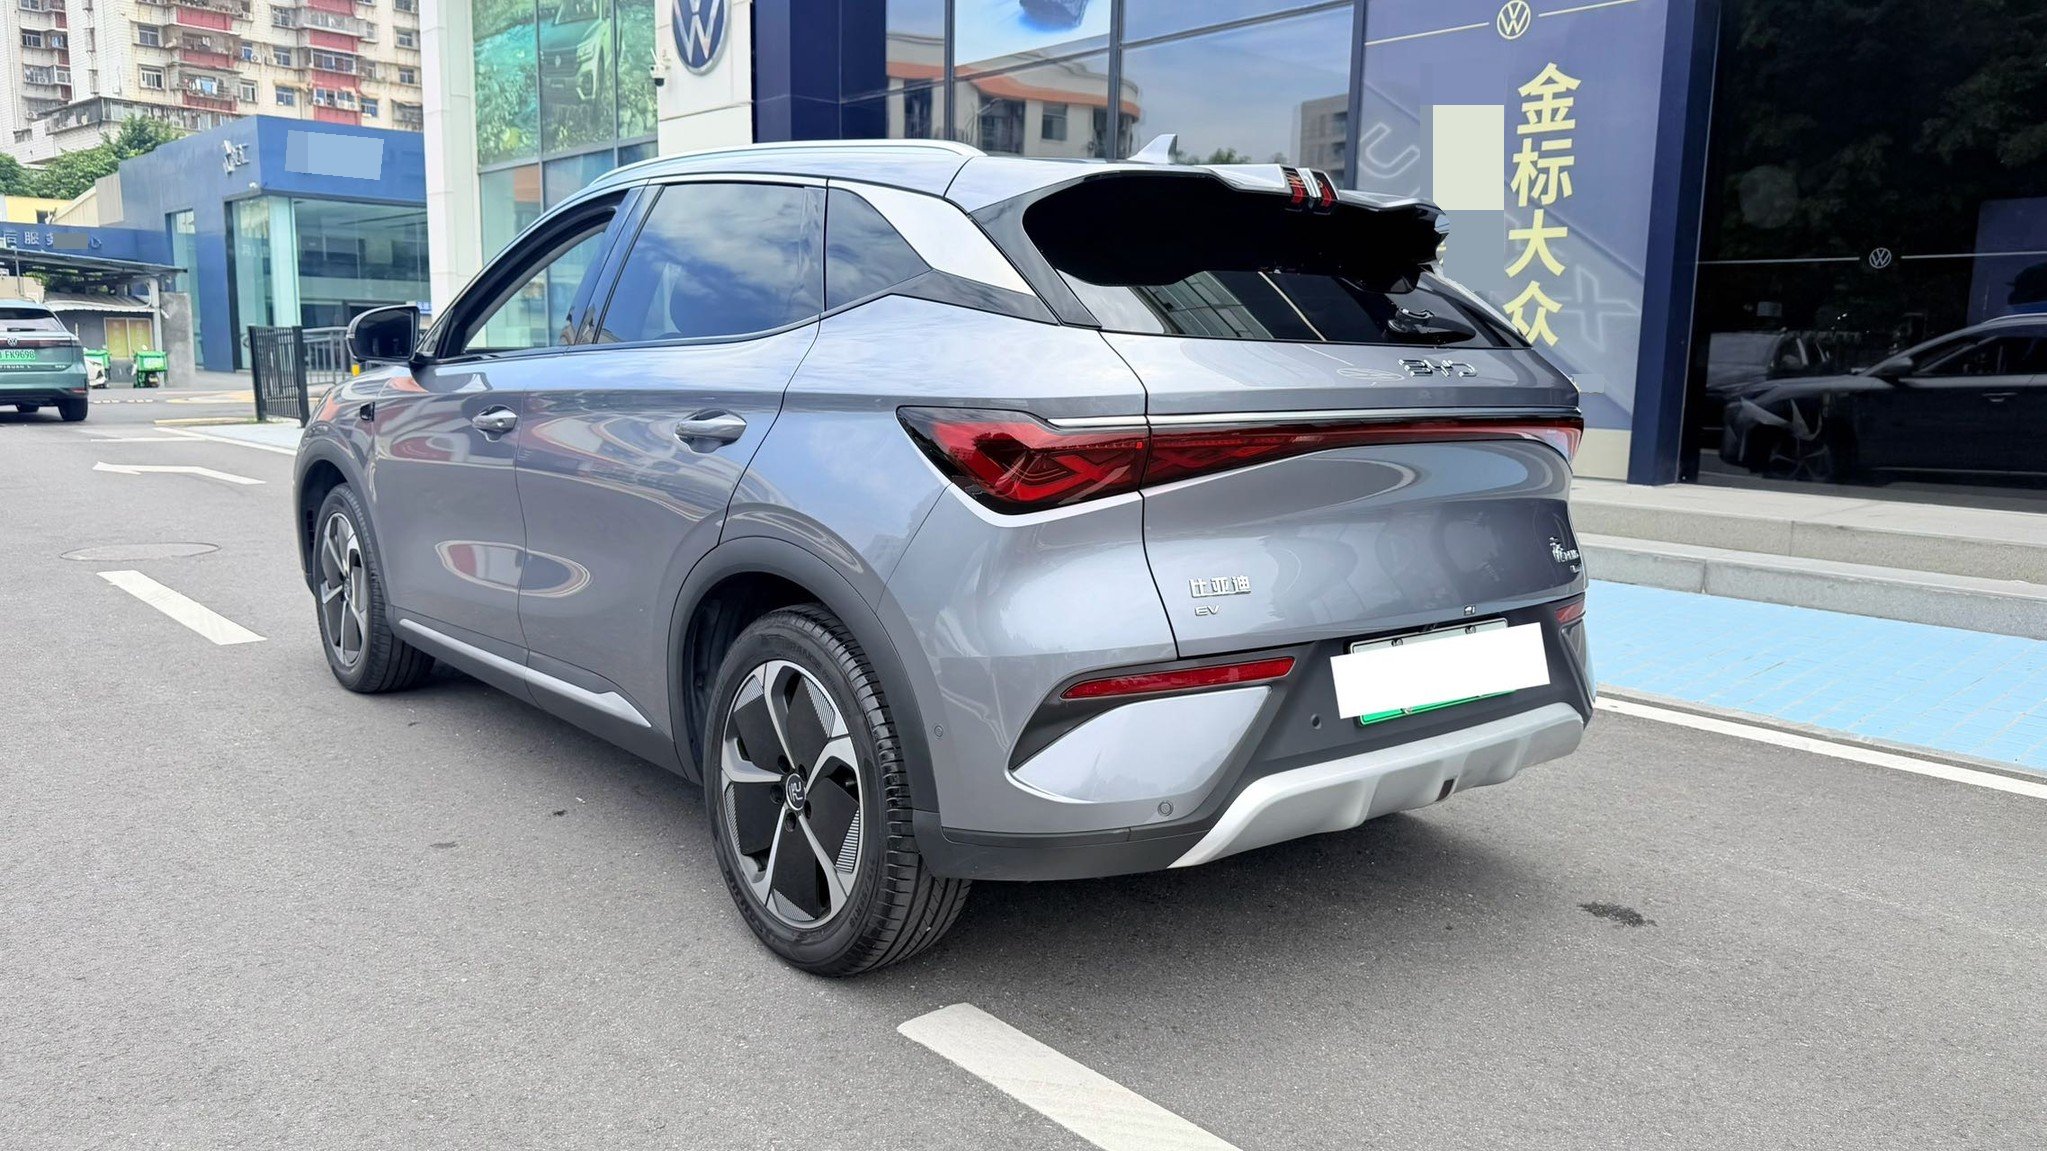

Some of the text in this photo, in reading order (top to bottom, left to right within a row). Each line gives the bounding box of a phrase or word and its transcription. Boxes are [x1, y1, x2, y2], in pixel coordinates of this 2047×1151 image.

[1502, 62, 1582, 347] 金标大众
[1398, 359, 1478, 377] BYD
[1189, 575, 1251, 598] 比亚迪
[1194, 605, 1220, 616] EV
